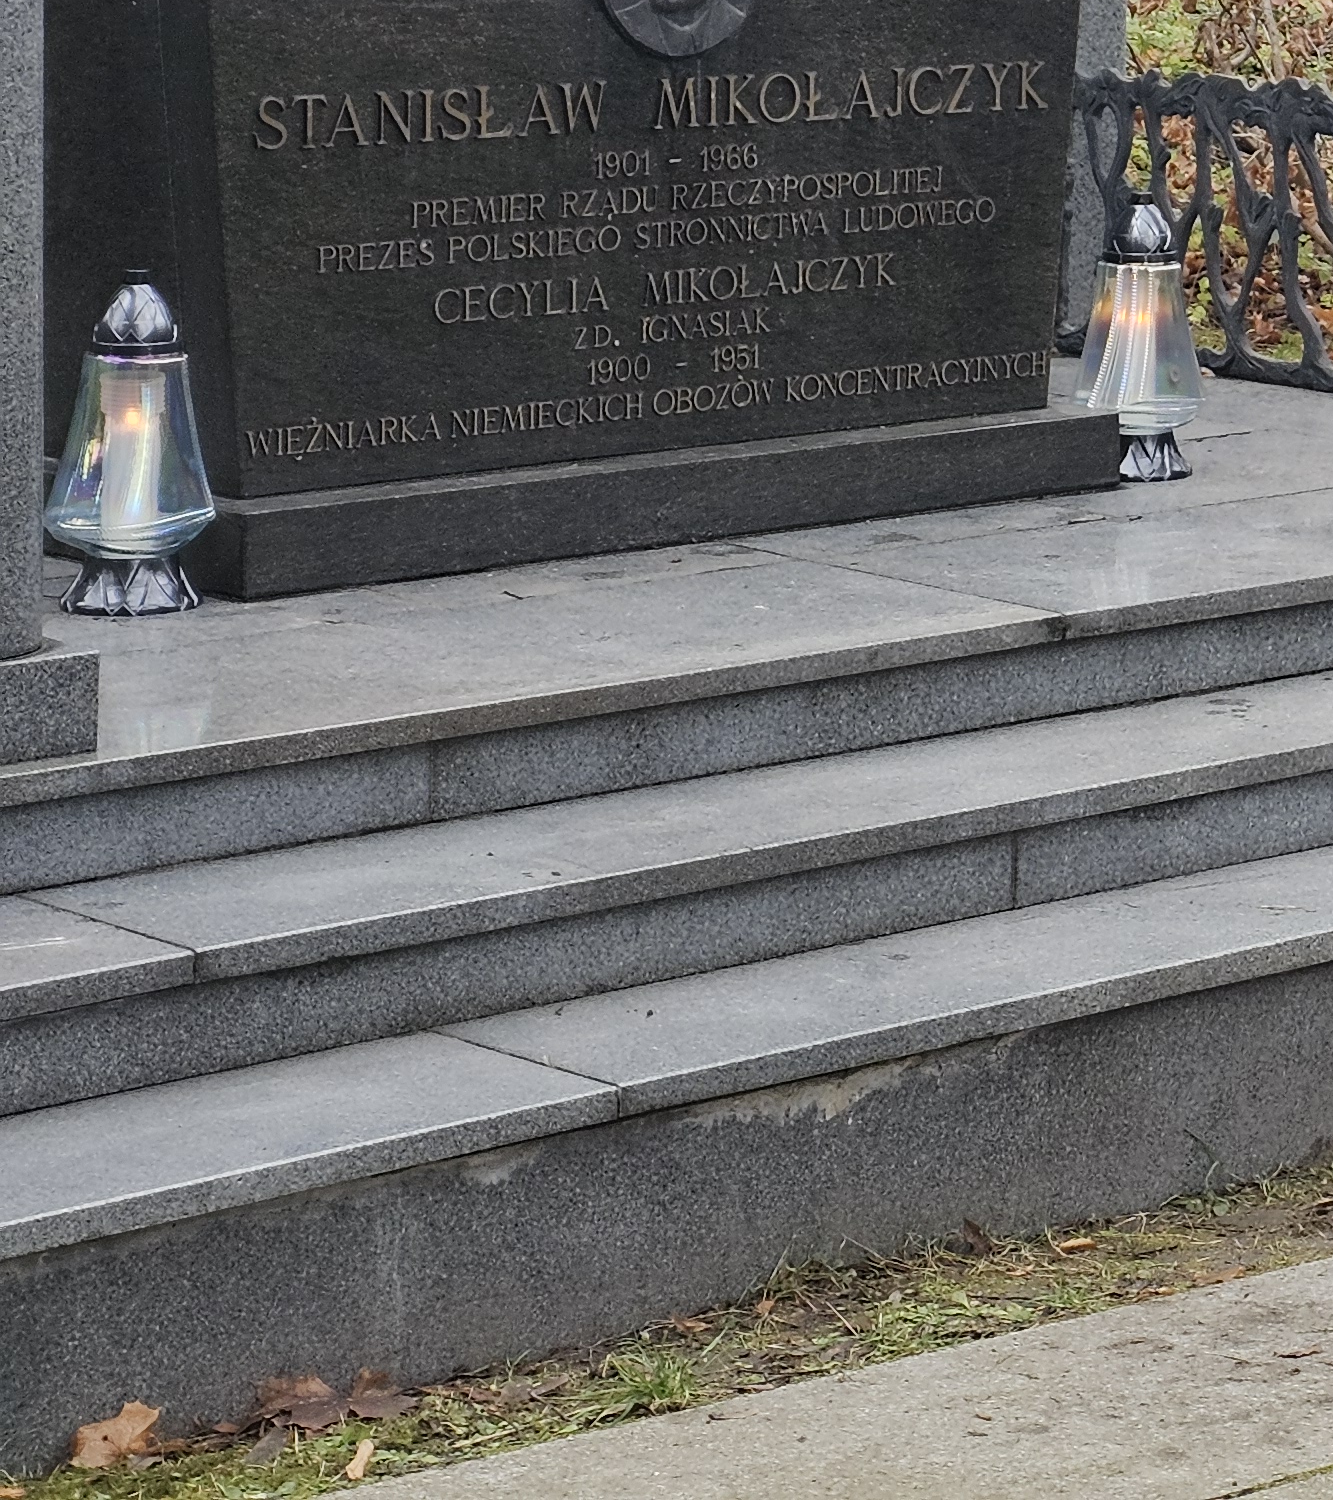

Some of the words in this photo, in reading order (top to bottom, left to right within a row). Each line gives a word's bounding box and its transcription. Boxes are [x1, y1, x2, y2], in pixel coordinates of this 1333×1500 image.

[252, 79, 607, 150] STANISŁAW
[654, 60, 1049, 130] MIKOŁAJCZYK
[594, 149, 651, 180] 1901
[700, 143, 758, 173] 1966
[411, 192, 546, 229] PREMIER
[560, 185, 659, 221] RZĄDU
[672, 166, 943, 210] RZECZYPOSPOLITEJ
[316, 238, 435, 274] PREZES
[447, 224, 621, 264] POLSKIEGO
[634, 208, 830, 249] STRONNICTWA
[843, 197, 996, 234] LUDOWEGO
[434, 276, 610, 324] CECYLIA
[643, 252, 898, 306] MIKOŁAJCZYK
[640, 306, 771, 344] IGNASIAK
[450, 392, 643, 438] NIEMIECKICH
[653, 375, 775, 416] OBOZÓW
[785, 350, 1048, 402] KONCENTRACYJNYCH
[587, 353, 650, 386] 1900
[710, 342, 759, 373] 1951
